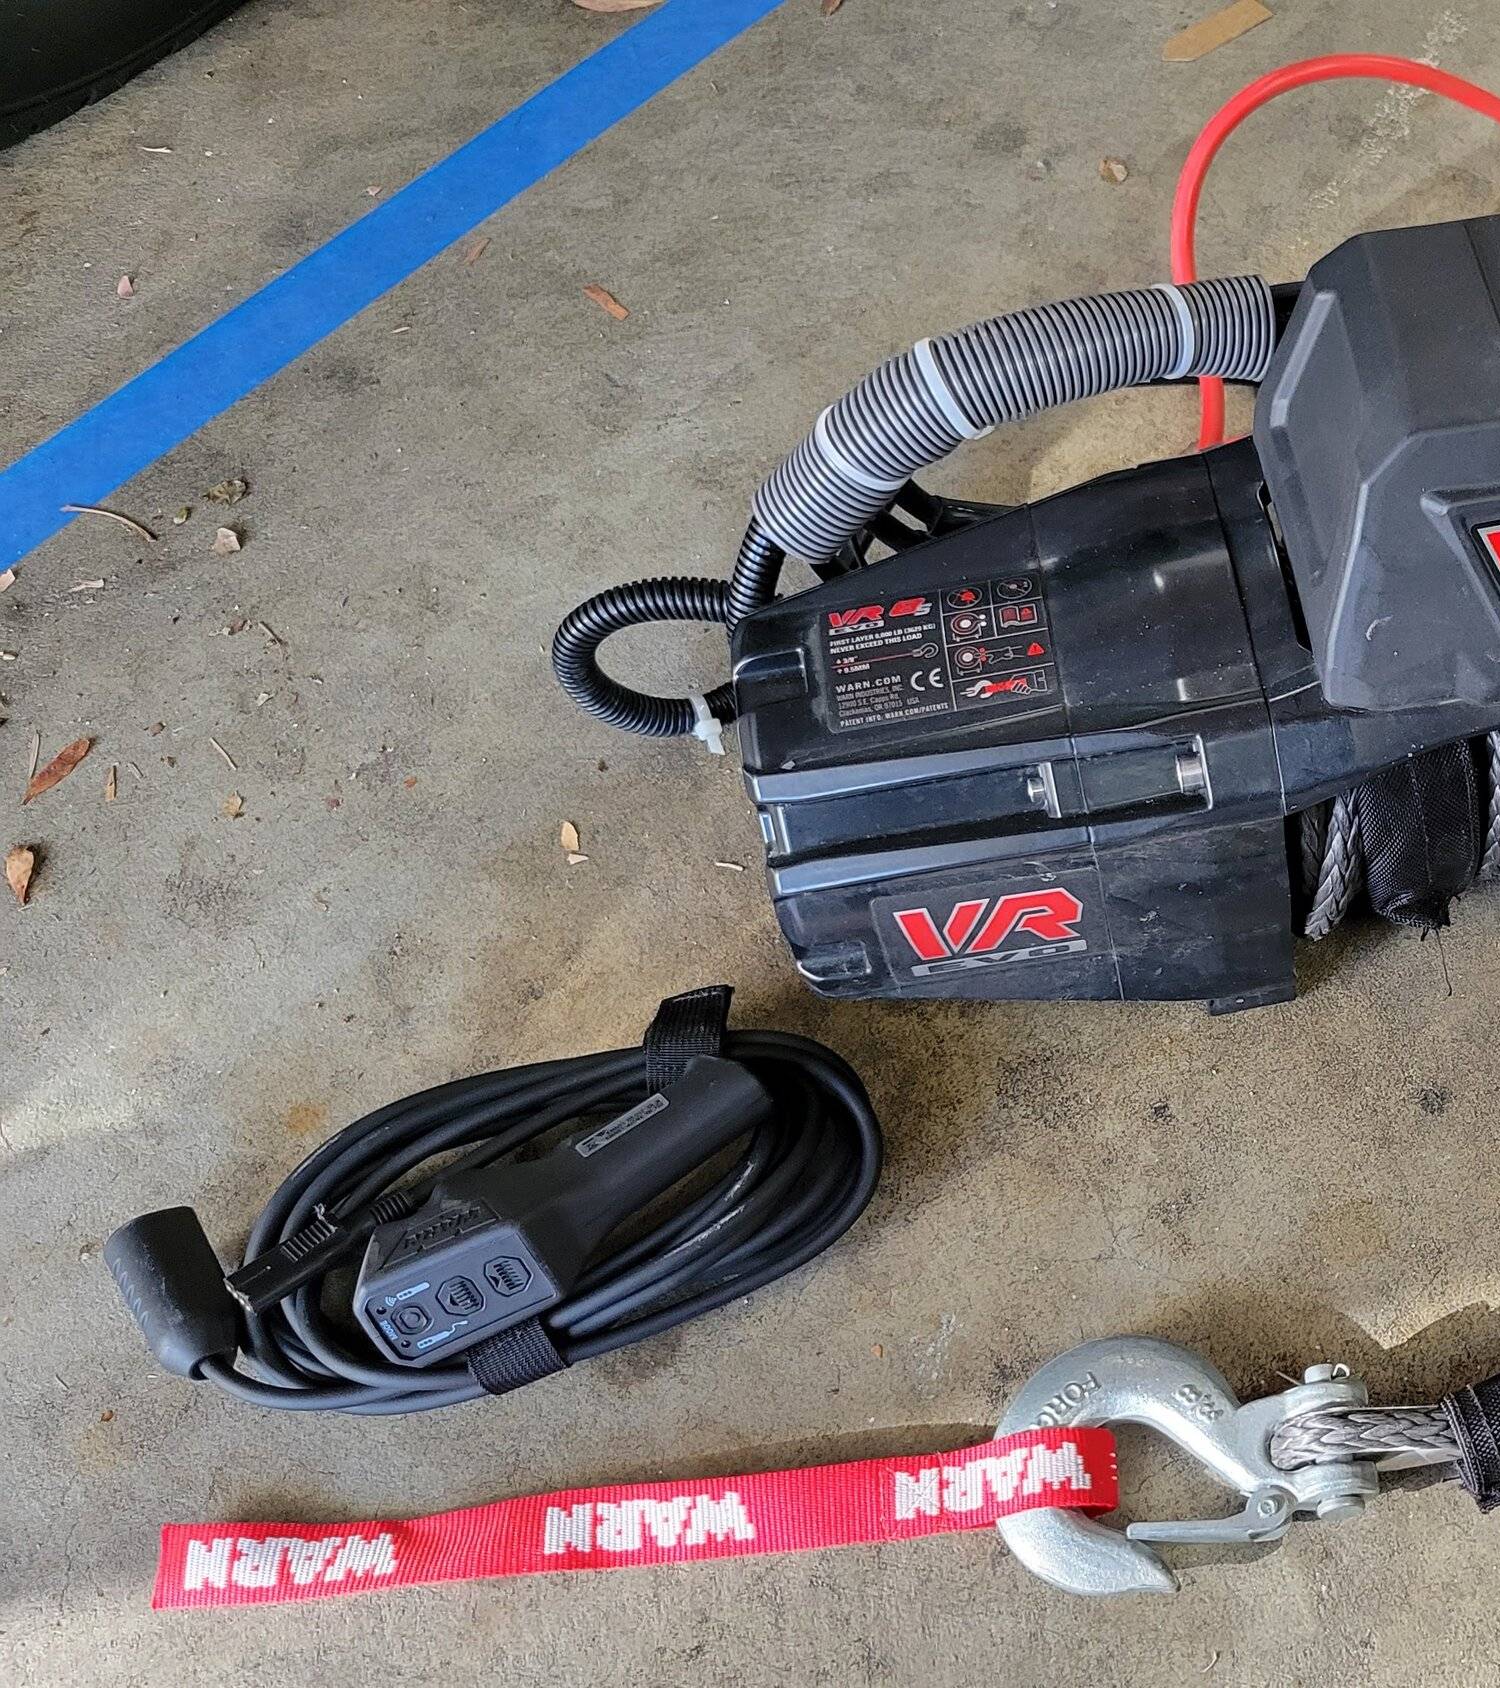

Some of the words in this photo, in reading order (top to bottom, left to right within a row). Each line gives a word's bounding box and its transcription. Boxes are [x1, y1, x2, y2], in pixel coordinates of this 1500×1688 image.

[828, 604, 885, 628] VR
[828, 620, 885, 636] EVO
[829, 637, 850, 647] FIRST
[851, 634, 874, 644] LAYER
[830, 644, 855, 655] NEVER
[855, 640, 884, 650] EXCEED
[884, 637, 902, 645] THIS
[902, 633, 923, 642] LOAD
[836, 675, 901, 693] WARN.COM
[840, 717, 864, 728] PATENT
[892, 887, 1084, 961] VR
[911, 939, 1088, 977] EVO
[1029, 1370, 1103, 1428] FORG
[894, 1441, 1093, 1521] WARN
[543, 1490, 756, 1556] WARN
[182, 1531, 399, 1592] WARN
